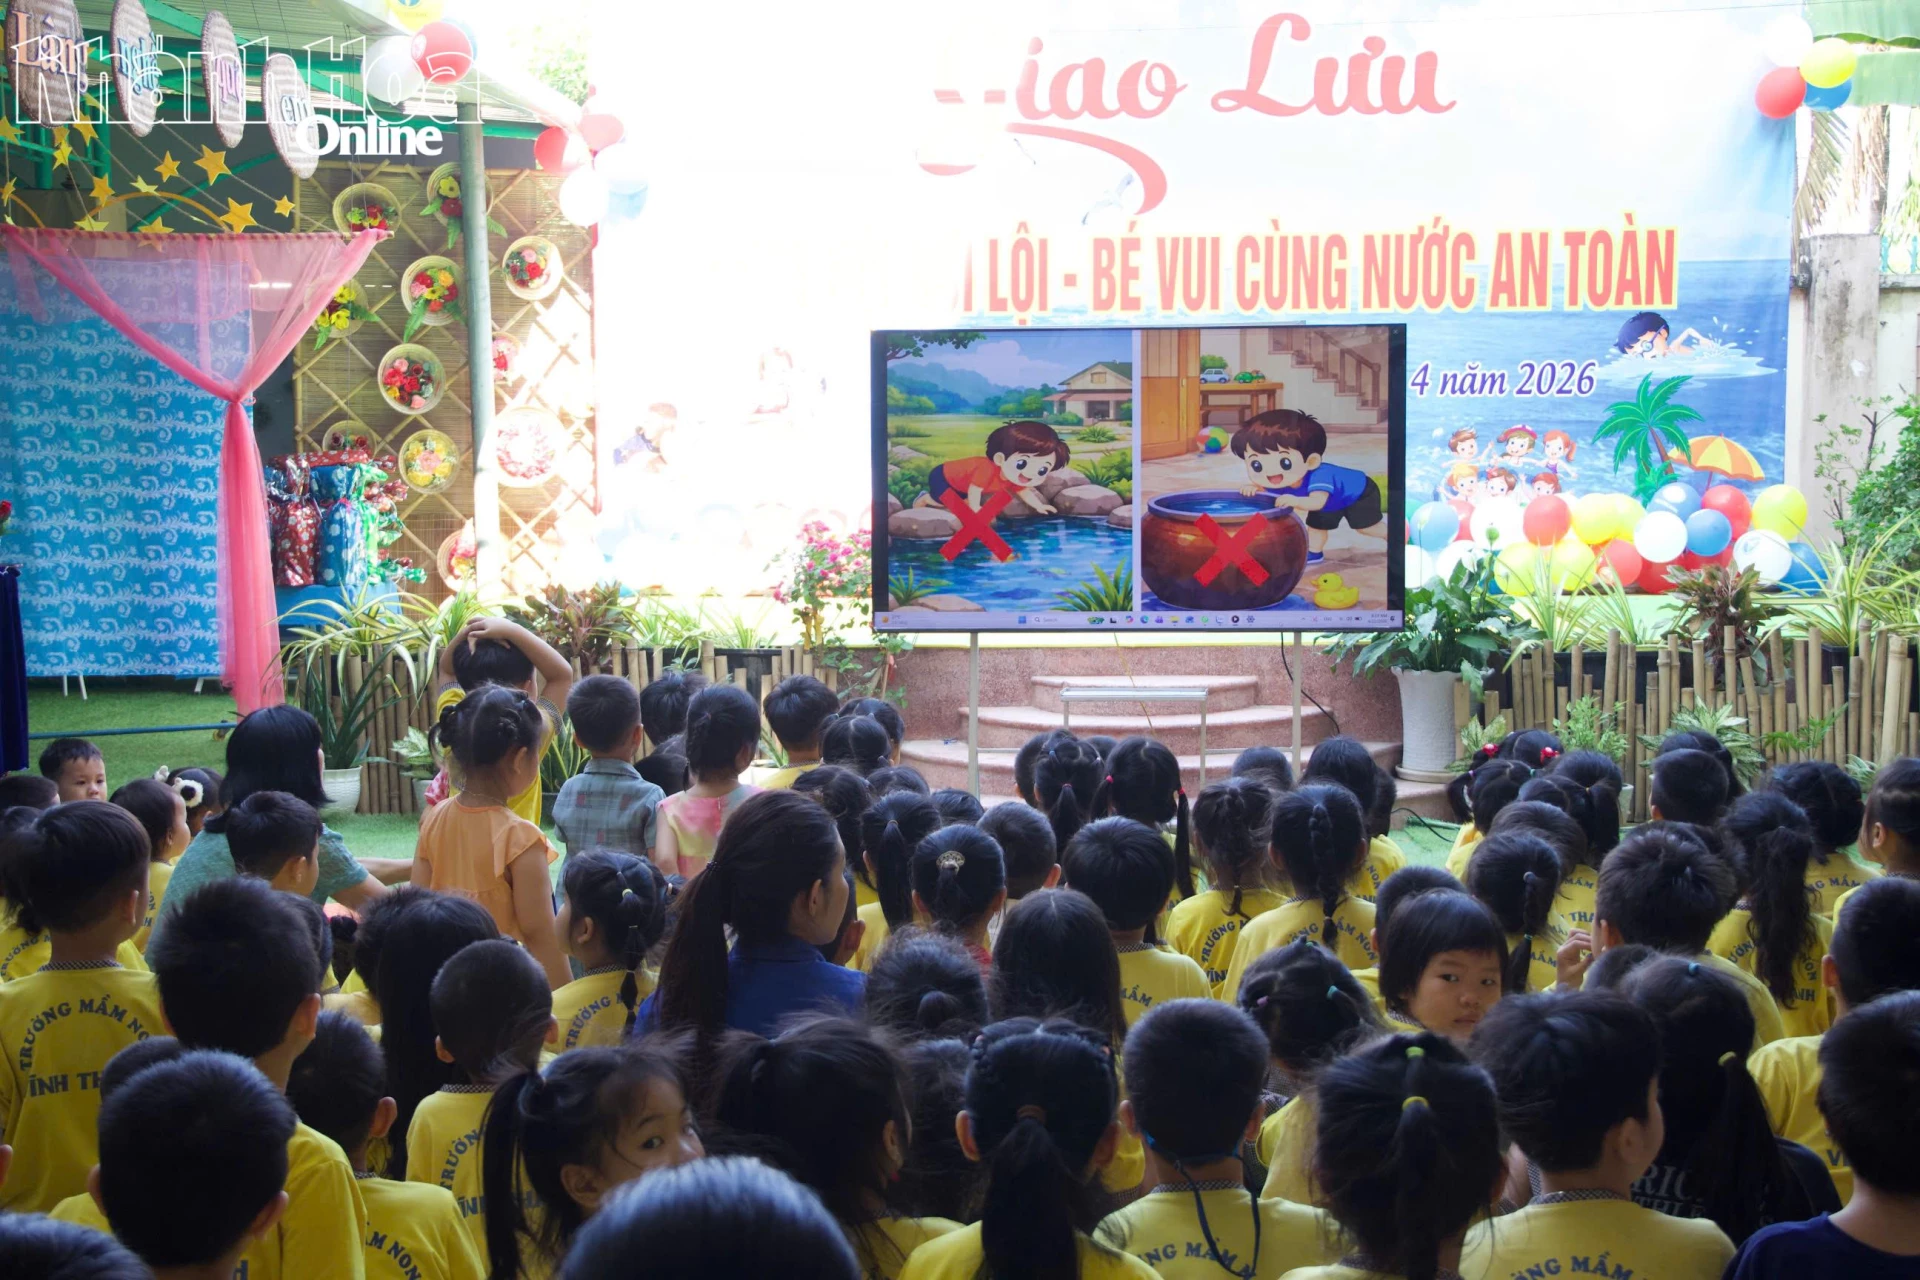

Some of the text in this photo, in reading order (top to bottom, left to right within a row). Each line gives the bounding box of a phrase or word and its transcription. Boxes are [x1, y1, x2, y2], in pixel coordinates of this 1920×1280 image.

[1211, 13, 1457, 116] Lưu
[989, 221, 1048, 326] LỘI
[1093, 221, 1141, 311] BÉ
[1157, 236, 1220, 311] VUI
[1236, 219, 1348, 311] CÙNG
[1363, 217, 1476, 310] NƯỚC
[1490, 232, 1549, 307] AN
[1564, 213, 1677, 307] TOÀN
[1410, 362, 1596, 397] 4 năm 2026
[19, 1002, 72, 1071] TRƯỜNG
[439, 1125, 487, 1191] TRƯỜN
